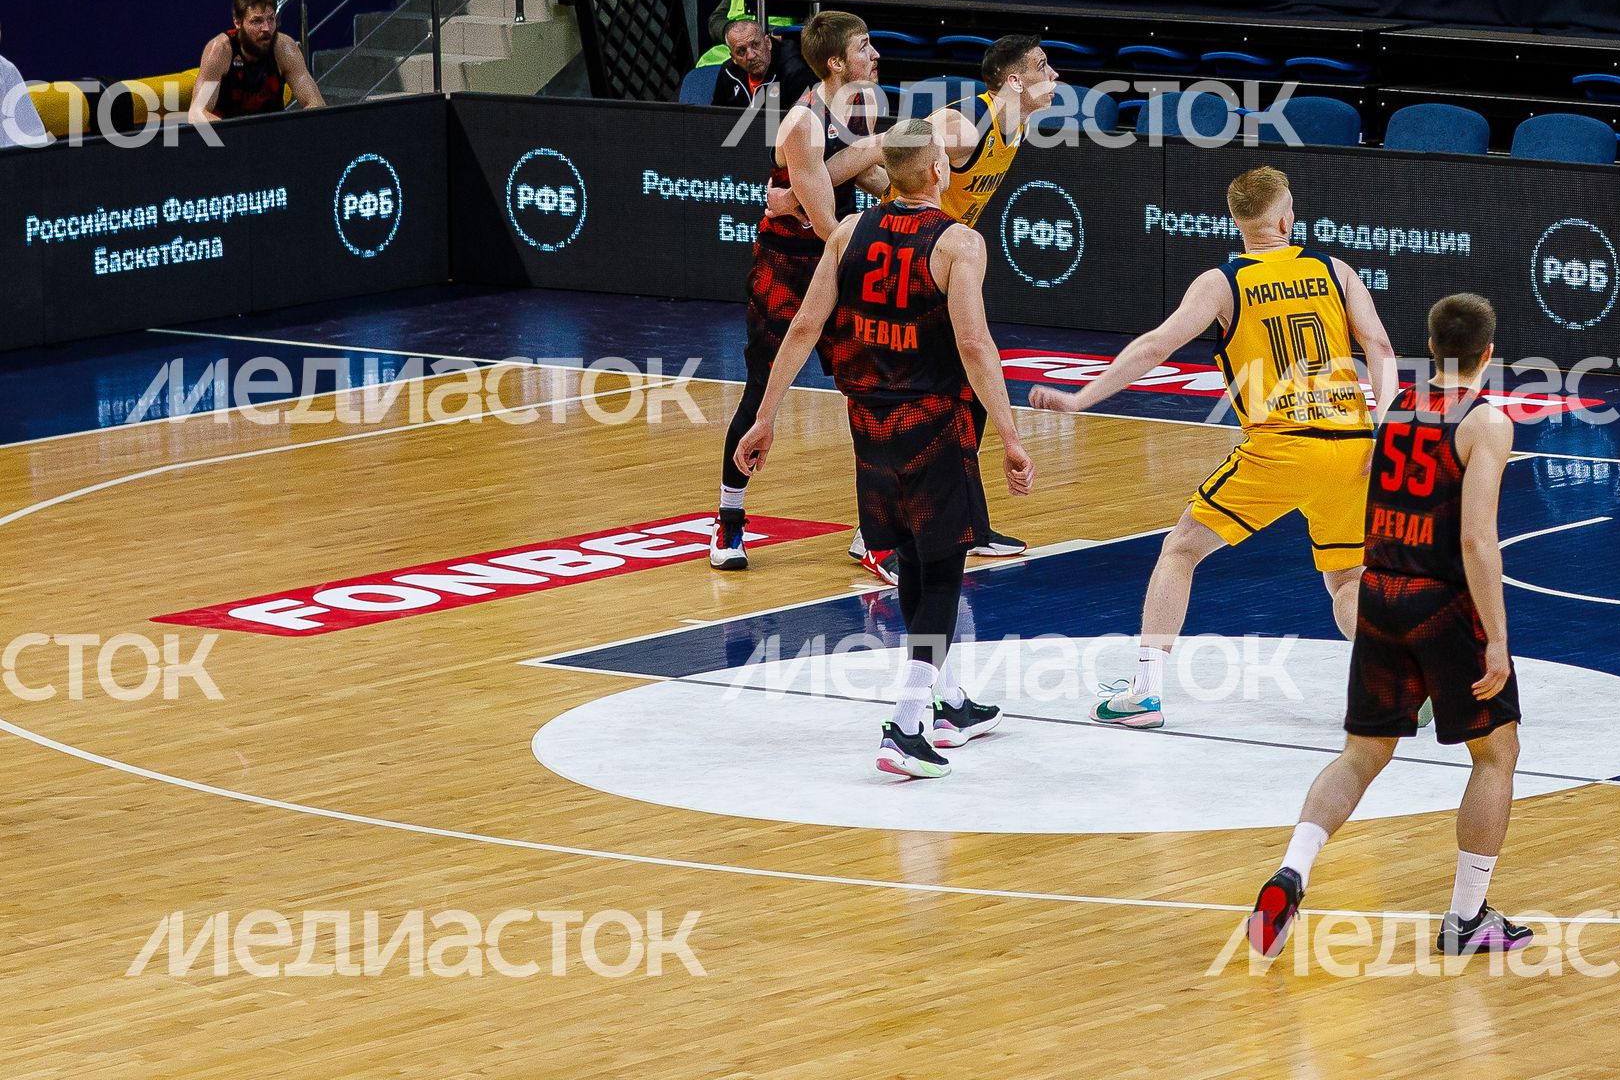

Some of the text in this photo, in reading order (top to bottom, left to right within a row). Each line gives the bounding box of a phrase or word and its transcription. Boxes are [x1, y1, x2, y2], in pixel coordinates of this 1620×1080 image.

[342, 186, 394, 221] РФБ
[516, 183, 578, 216] РФБ
[641, 169, 768, 205] Российск
[26, 185, 290, 246] Российская Федерация
[1012, 216, 1074, 250] РФБ
[93, 234, 225, 276] Баскетбола
[1313, 216, 1472, 256] Федерация
[861, 240, 915, 309] 21
[1245, 277, 1329, 307] МАЛЬЦЕВ
[1542, 256, 1608, 293] РФБ
[854, 315, 918, 352] РЕВДА
[1261, 312, 1333, 382] 10
[1266, 386, 1357, 413] МОСКОВСКАЯ
[1380, 421, 1443, 498] 55
[1371, 507, 1434, 547] РЕВДА
[226, 515, 770, 631] FONBET
